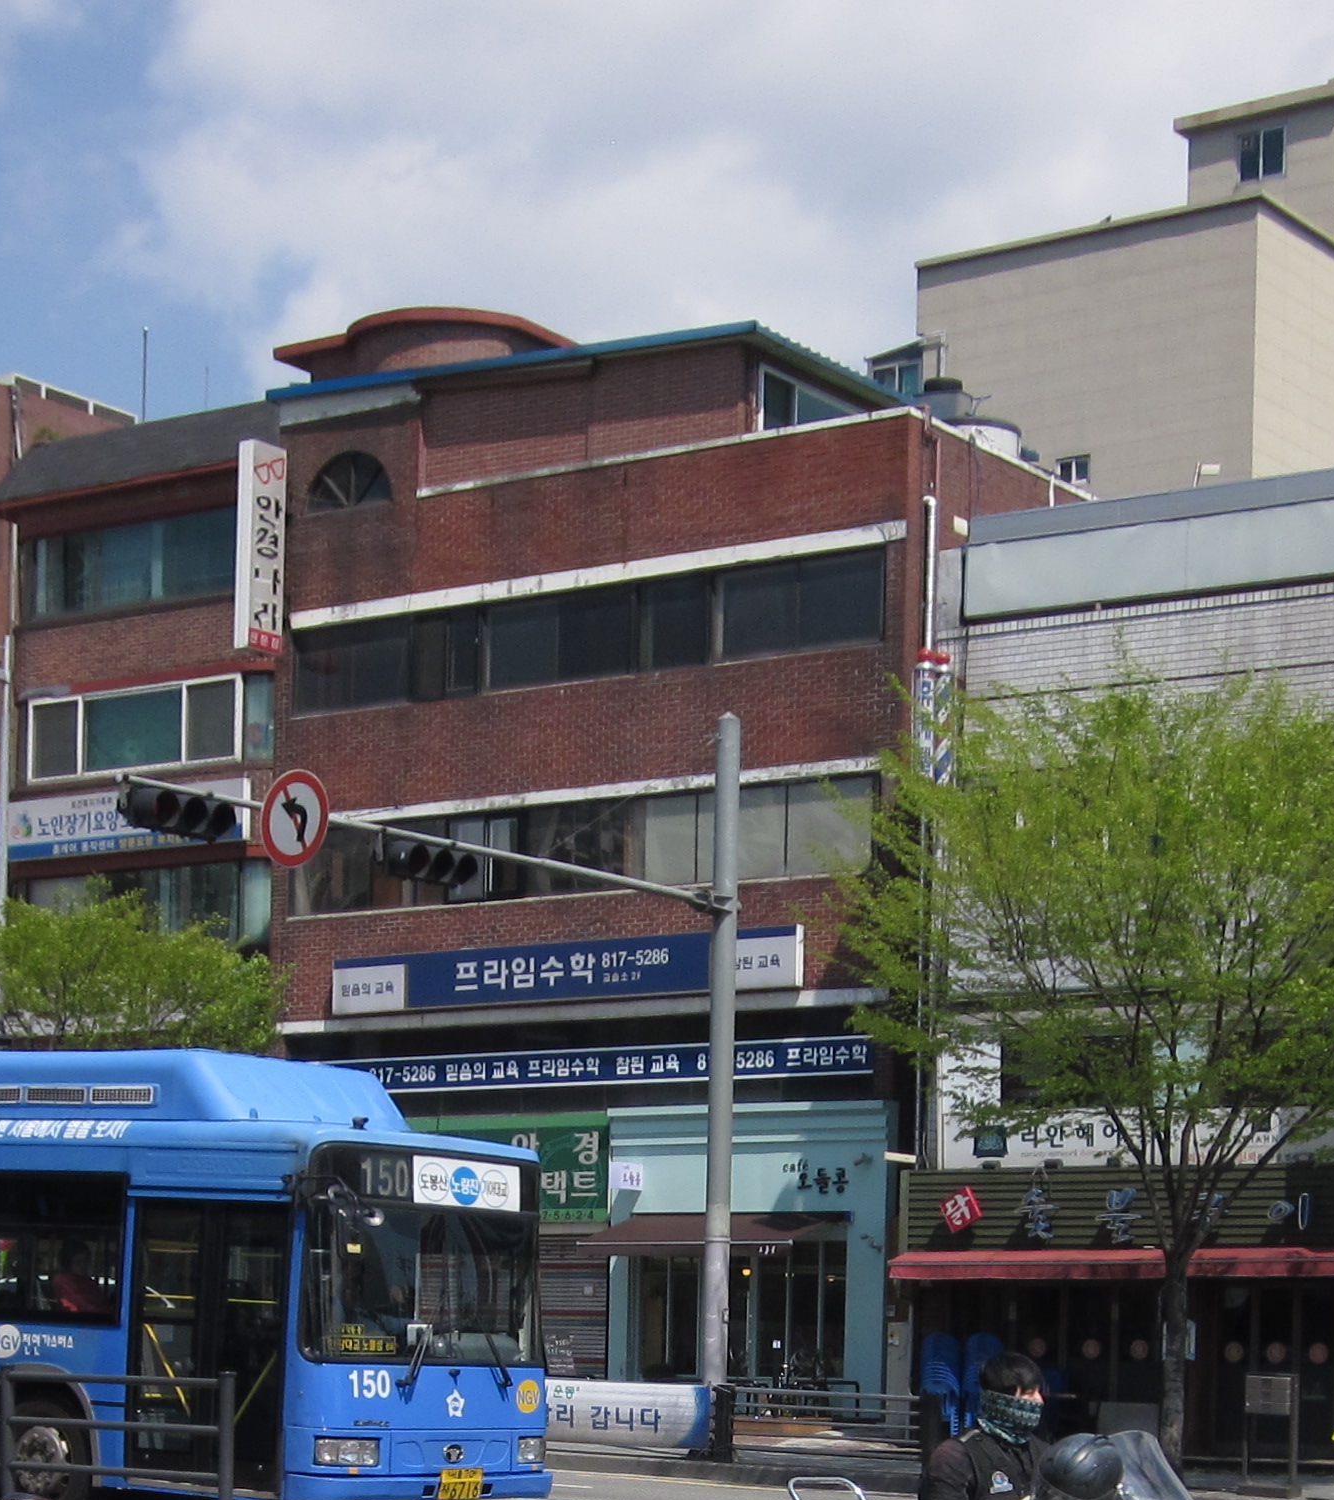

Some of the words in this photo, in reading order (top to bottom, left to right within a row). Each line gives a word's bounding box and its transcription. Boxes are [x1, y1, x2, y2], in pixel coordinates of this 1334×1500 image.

[454, 952, 596, 992] 프라임수학
[601, 948, 670, 969] 817-5286
[757, 953, 782, 969] 교육
[341, 983, 371, 998] 믿음의
[374, 980, 395, 995] 교육
[446, 1061, 487, 1083] 믿음의
[492, 1059, 519, 1081] 교육
[527, 1057, 600, 1078] 프라임수학
[616, 1055, 645, 1076] 참된
[650, 1054, 680, 1074] 교육
[786, 1044, 867, 1067] 프라임수학
[1020, 1122, 1124, 1148] 리안헤어
[360, 1156, 408, 1197] 150
[782, 1158, 809, 1173] café
[420, 1173, 448, 1192] 도봉산
[452, 1178, 481, 1196] 노량진
[541, 1171, 599, 1204] 택트
[349, 1369, 391, 1398] 150
[518, 1388, 540, 1405] NGV
[590, 1404, 662, 1434] 갑니다
